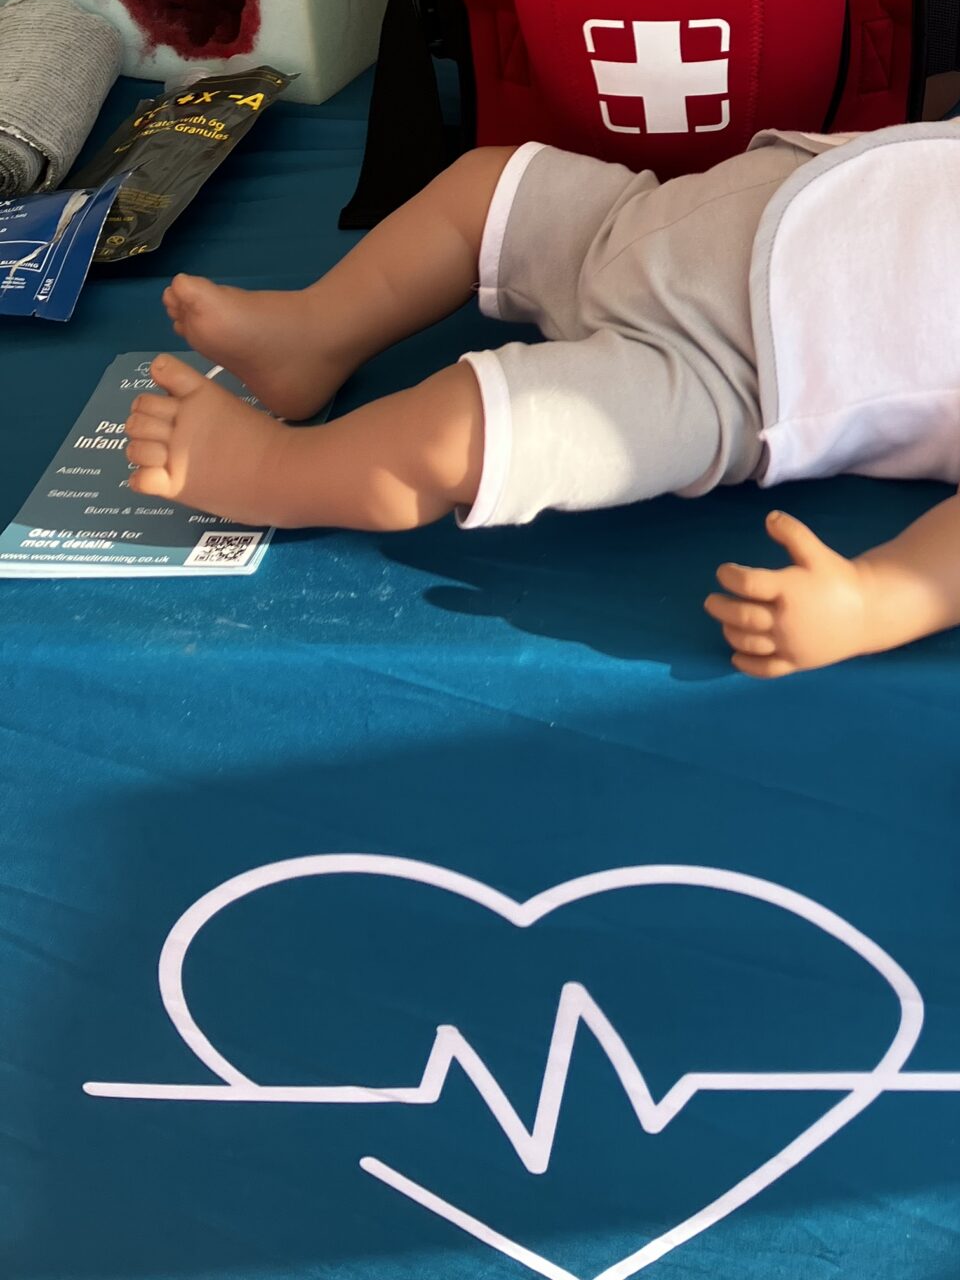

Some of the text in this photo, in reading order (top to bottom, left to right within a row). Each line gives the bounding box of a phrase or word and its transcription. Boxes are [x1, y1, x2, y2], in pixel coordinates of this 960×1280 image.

[208, 119, 226, 132] 6g
[174, 123, 230, 142] Granules
[74, 435, 129, 450] Infant
[56, 466, 102, 476] Asthma
[47, 489, 100, 499] Seizures
[84, 506, 118, 515] Burns
[134, 507, 175, 516] Scalds
[188, 515, 217, 524] Plus
[28, 528, 144, 540] Get in touch for
[20, 539, 60, 549] more
